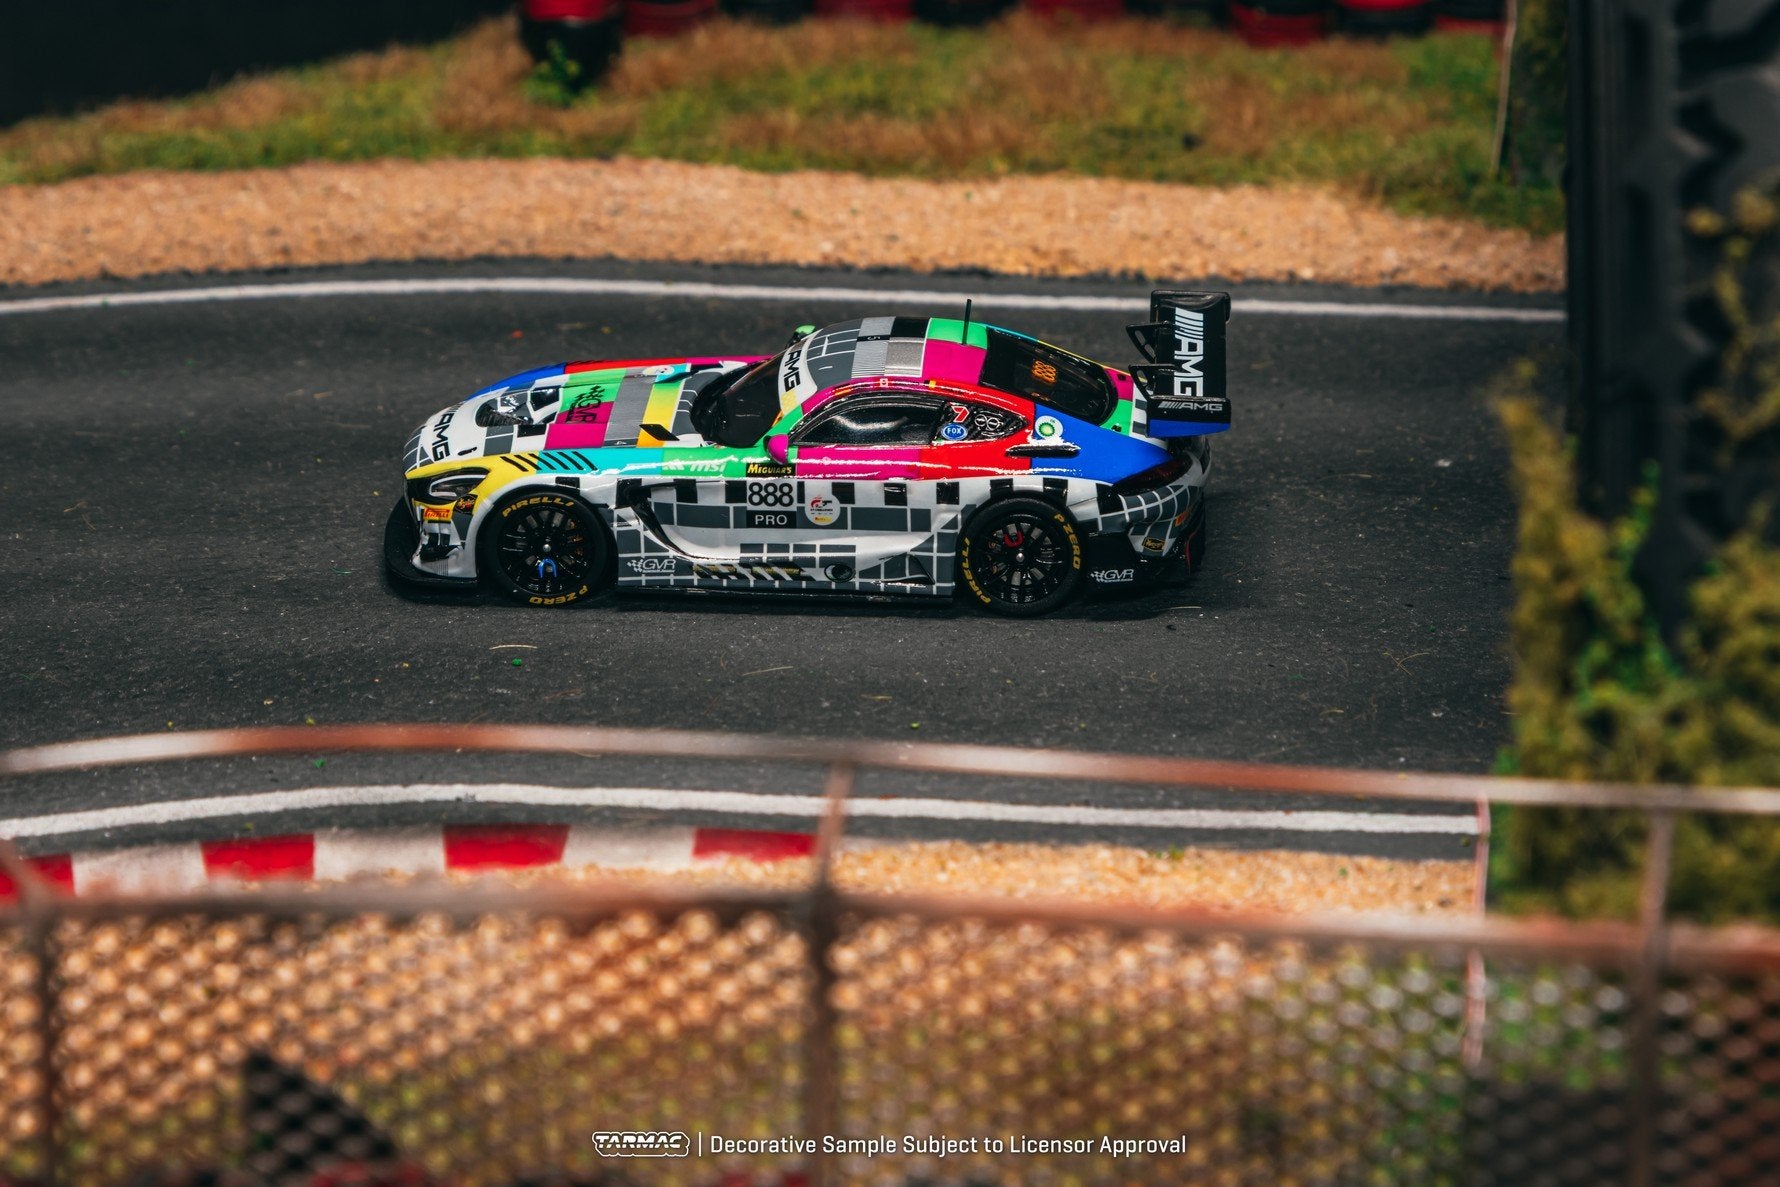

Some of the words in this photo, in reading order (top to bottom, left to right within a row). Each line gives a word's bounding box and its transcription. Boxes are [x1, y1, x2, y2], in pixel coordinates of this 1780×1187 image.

[783, 349, 802, 392] AMG
[432, 412, 455, 462] AMG
[946, 427, 963, 435] FOX
[748, 482, 794, 507] 888
[502, 496, 575, 518] PIRELLI
[755, 514, 788, 525] PRO
[643, 558, 677, 570] GVR
[962, 536, 992, 604] PIRELLI
[1104, 568, 1135, 580] GVR
